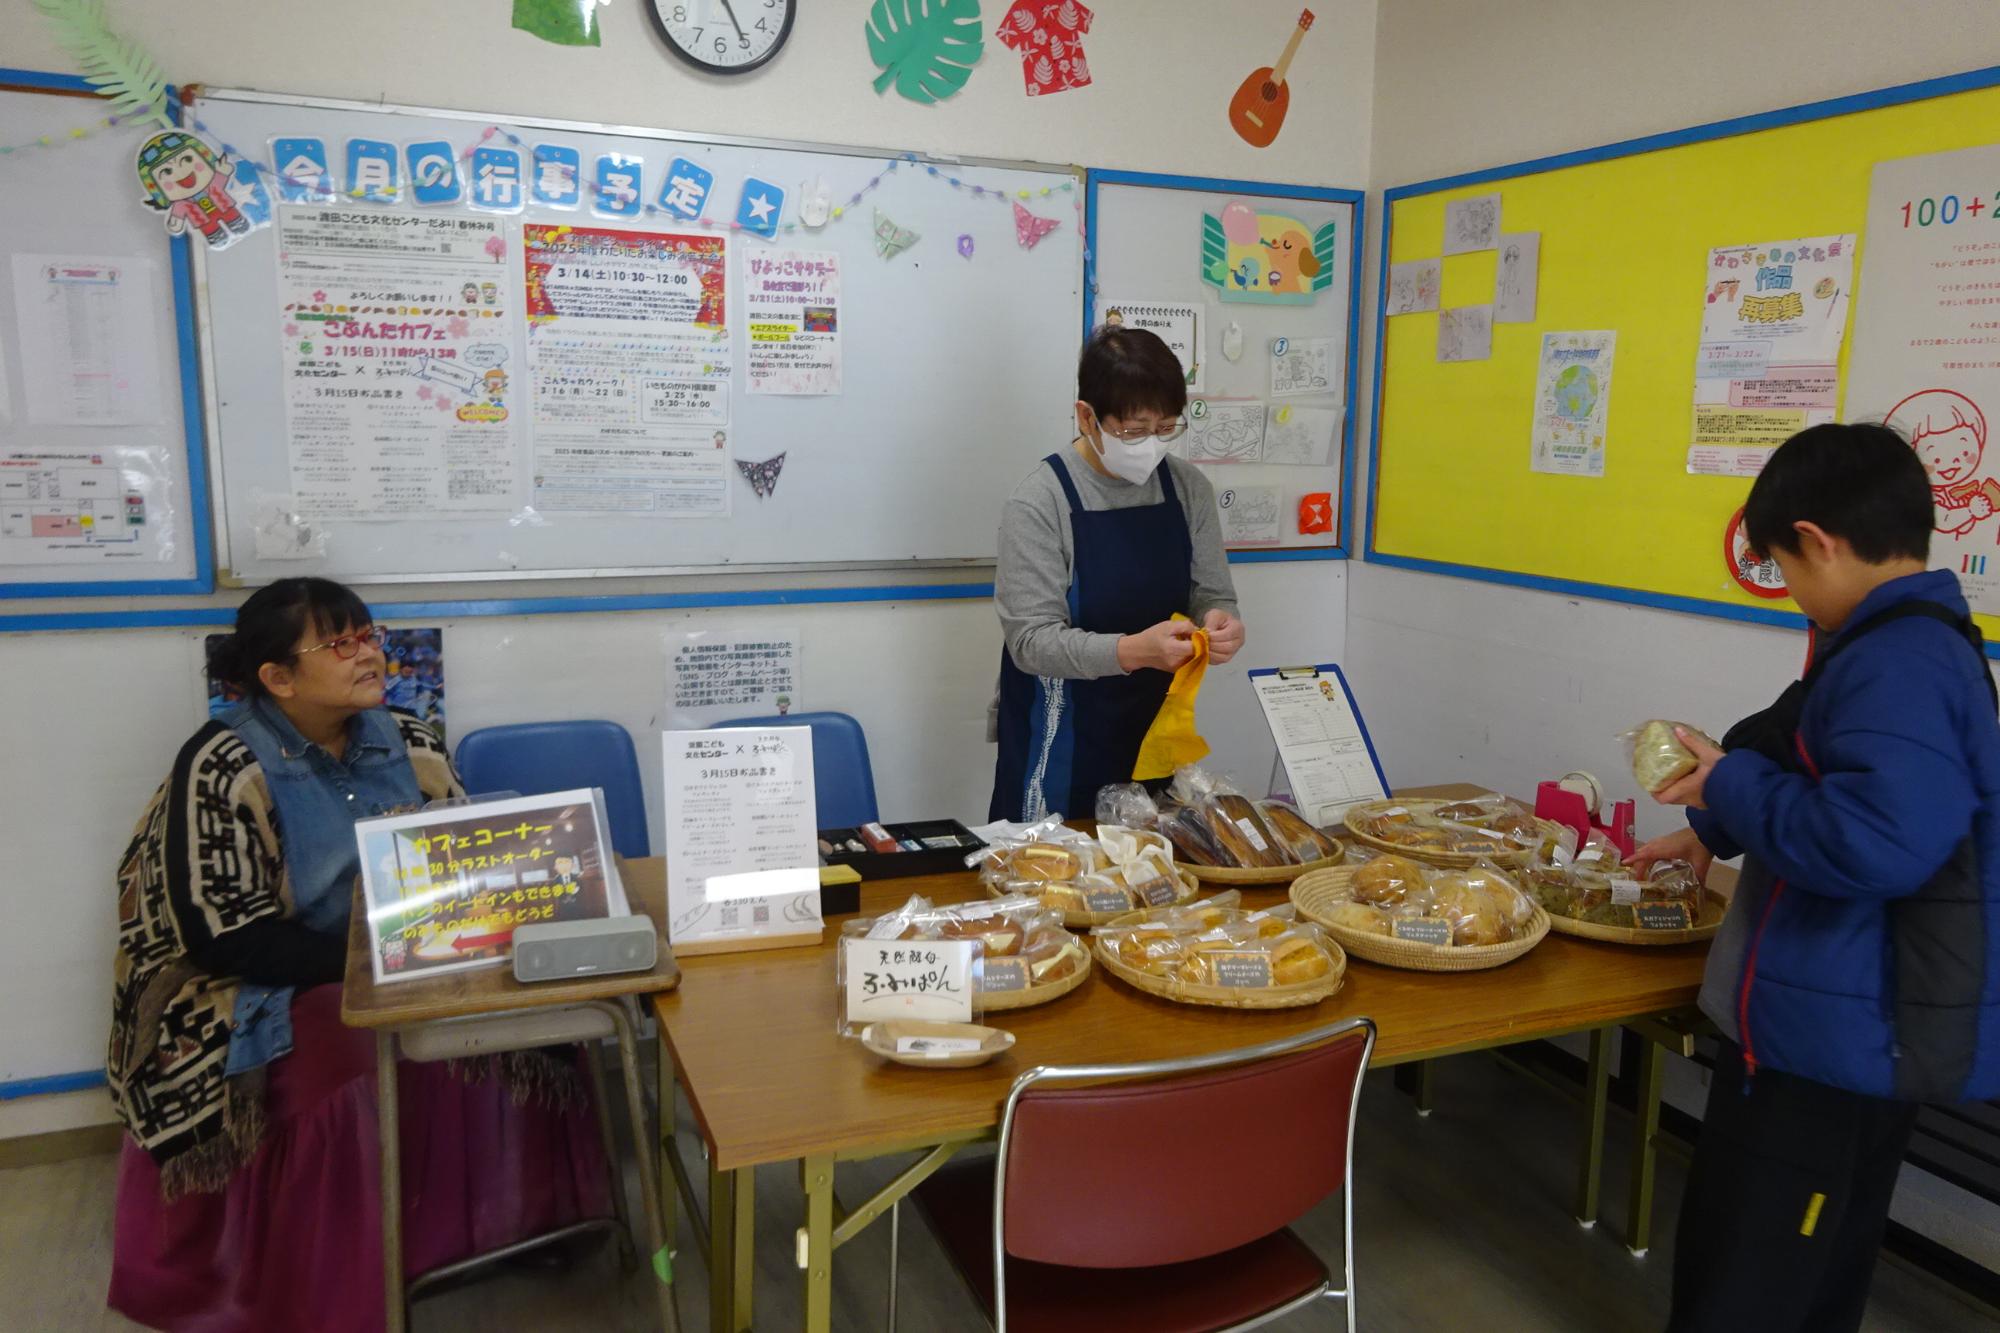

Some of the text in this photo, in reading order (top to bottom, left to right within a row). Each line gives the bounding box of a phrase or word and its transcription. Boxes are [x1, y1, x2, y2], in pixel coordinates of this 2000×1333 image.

[673, 5, 686, 23] 8
[755, 17, 767, 33] 4
[692, 27, 704, 43] 7
[714, 37, 727, 53] 6
[322, 319, 447, 341] こぶんたカフェ
[414, 822, 553, 854] カフェコーナー
